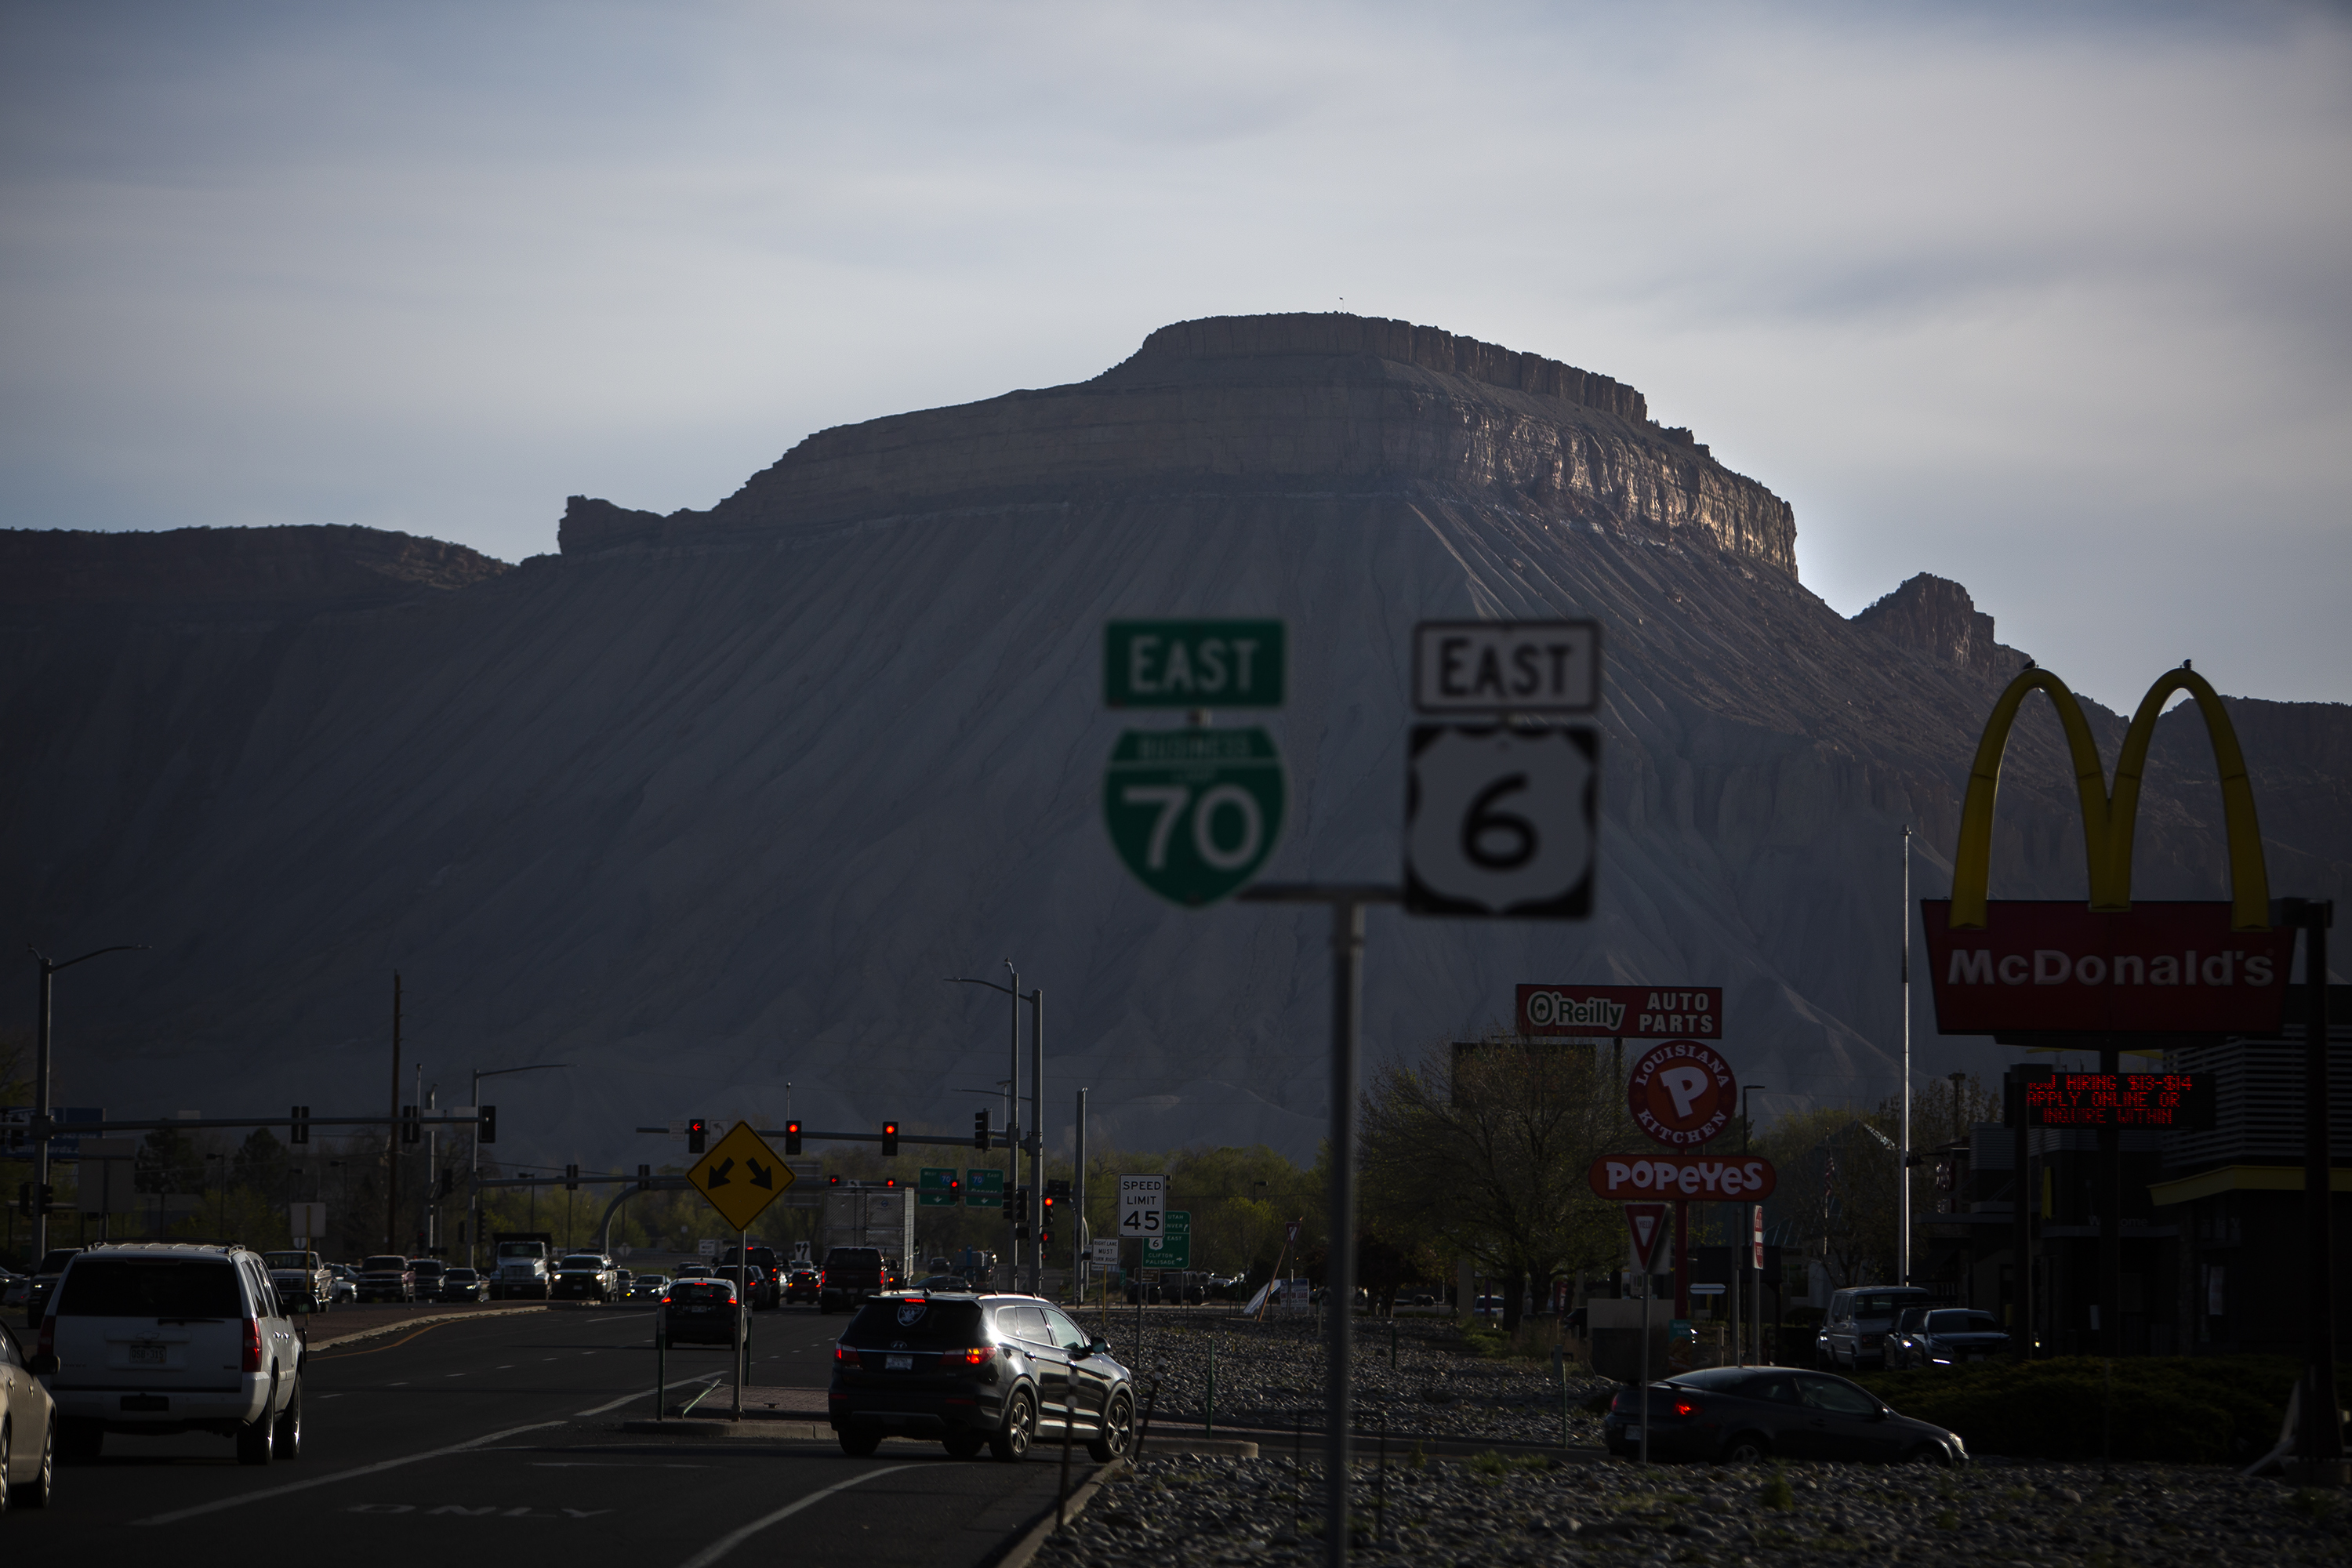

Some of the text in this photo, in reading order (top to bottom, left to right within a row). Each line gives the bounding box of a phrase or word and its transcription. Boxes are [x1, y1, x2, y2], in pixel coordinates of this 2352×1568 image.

[1127, 634, 1261, 694] EAST
[1439, 638, 1573, 698] EAST
[1120, 786, 1264, 872] 70
[1464, 773, 1537, 870] 6
[1946, 949, 2274, 986] McDonald's
[1527, 991, 1626, 1031] O'Reilly
[1646, 992, 1709, 1011] AUTO
[1639, 1014, 1714, 1033] PARTS
[1635, 1044, 1730, 1088] LOUISIANA
[1658, 1066, 1709, 1120] P
[2065, 1075, 2117, 1090] HIRING
[2127, 1075, 2193, 1091] $13-$14
[2027, 1091, 2180, 1107] APPLY ONLINE OR
[1636, 1109, 1727, 1145] KITCHEN
[2043, 1108, 2172, 1123] INQUIRE WITHIN
[1123, 1181, 1161, 1190] SPEED
[1123, 1210, 1160, 1230] 45
[1639, 1221, 1652, 1229] YIELD
[2088, 1215, 2149, 1227] Wome
